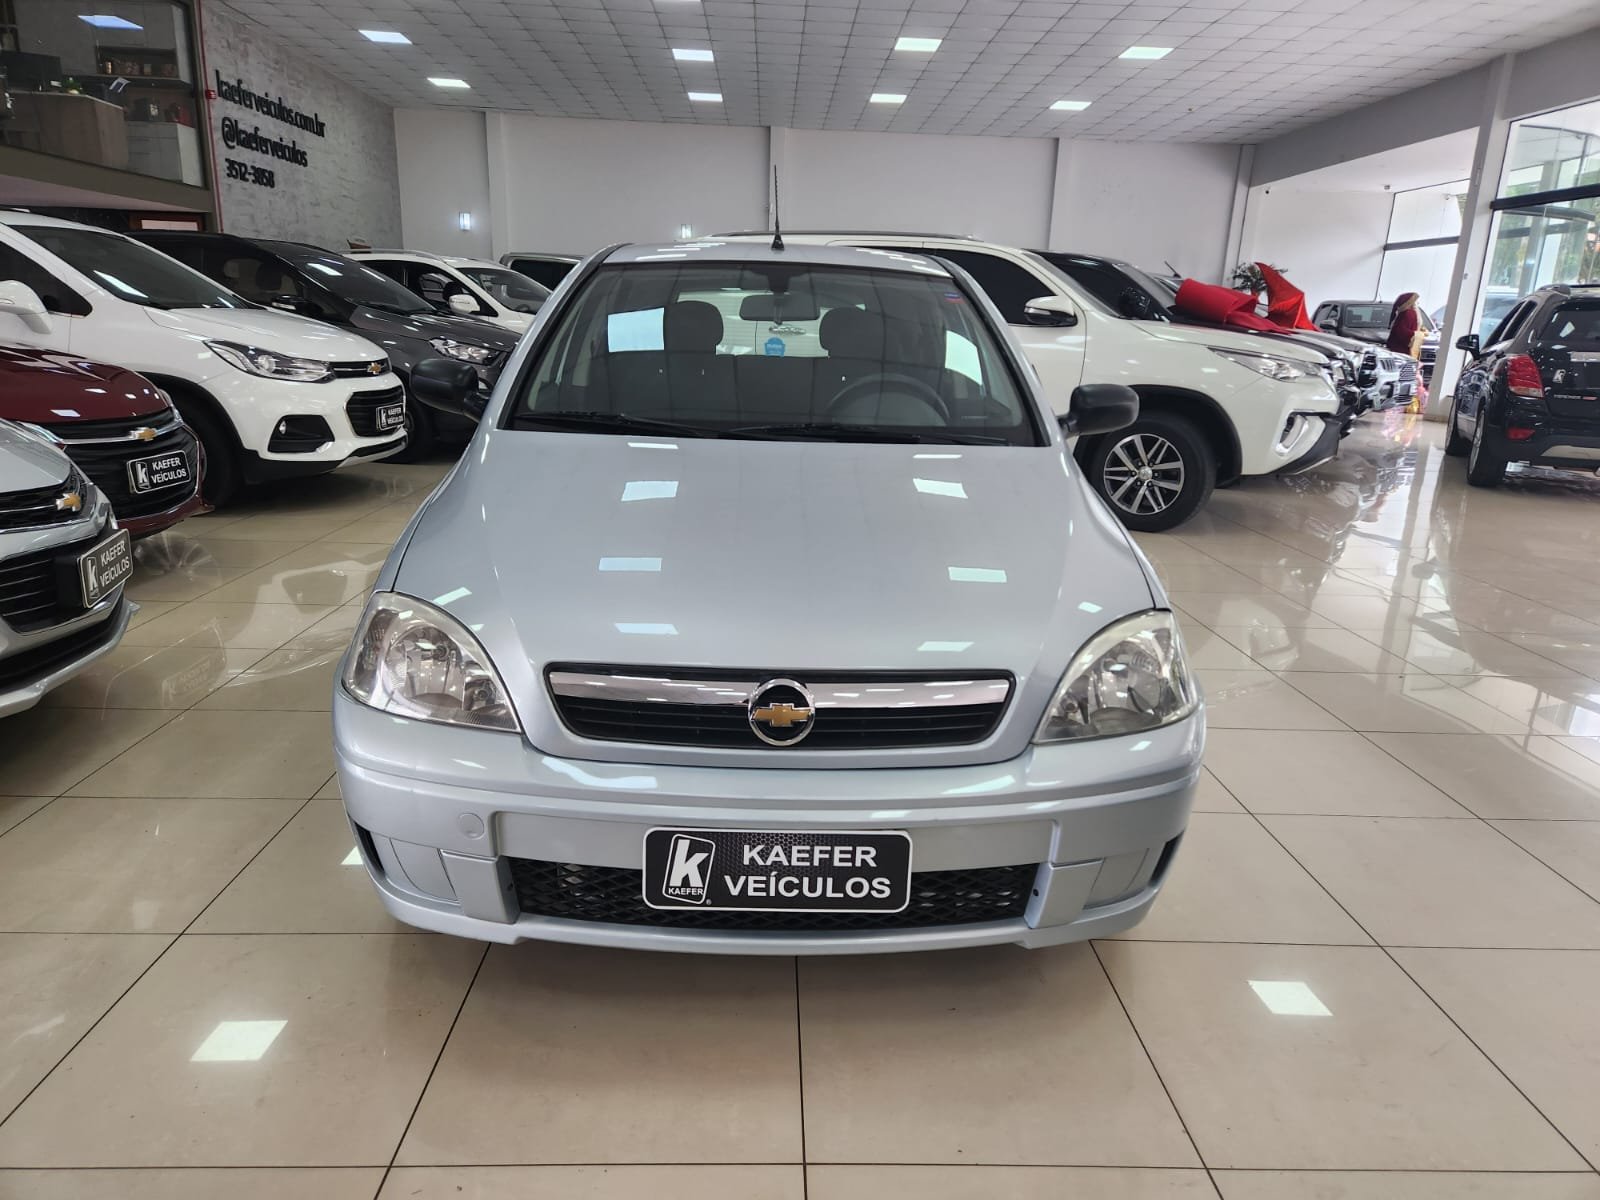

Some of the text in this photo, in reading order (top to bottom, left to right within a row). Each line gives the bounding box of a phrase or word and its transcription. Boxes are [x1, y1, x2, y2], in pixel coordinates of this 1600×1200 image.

[221, 116, 308, 167] @kaeferveiculos
[151, 468, 187, 483] VEÍCULOS
[152, 457, 181, 471] KAEFER
[100, 540, 126, 567] KAEFER
[743, 844, 877, 867] KAEFER
[668, 887, 704, 896] KAEFER
[724, 871, 891, 898] VEÍCULOS
